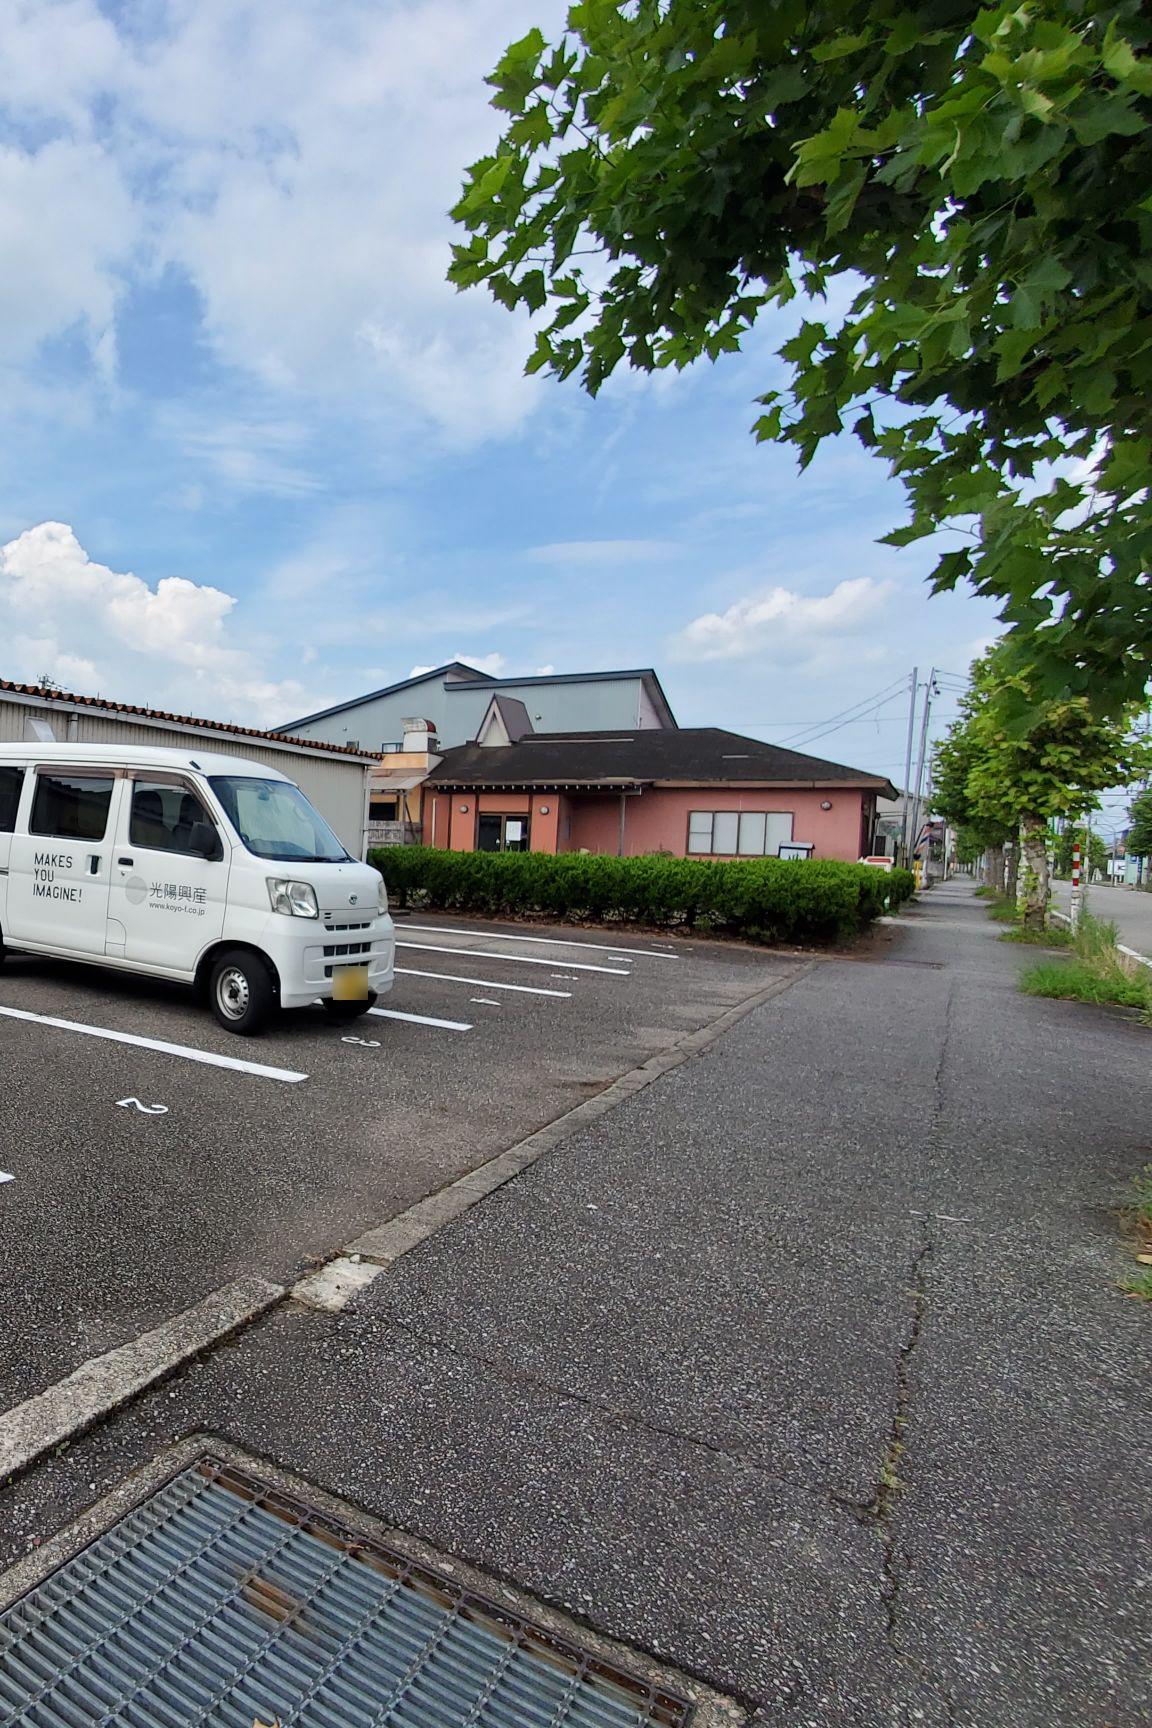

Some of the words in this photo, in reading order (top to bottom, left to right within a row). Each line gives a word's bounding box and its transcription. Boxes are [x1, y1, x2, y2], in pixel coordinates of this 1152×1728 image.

[34, 851, 73, 869] MAKES
[34, 868, 55, 883] YOU
[32, 883, 83, 904] IMAGINE!
[149, 881, 208, 905] 光陽興産
[148, 902, 206, 916] www.koyo-f.co.jp
[340, 1036, 382, 1047] 3
[115, 1096, 169, 1114] 2
